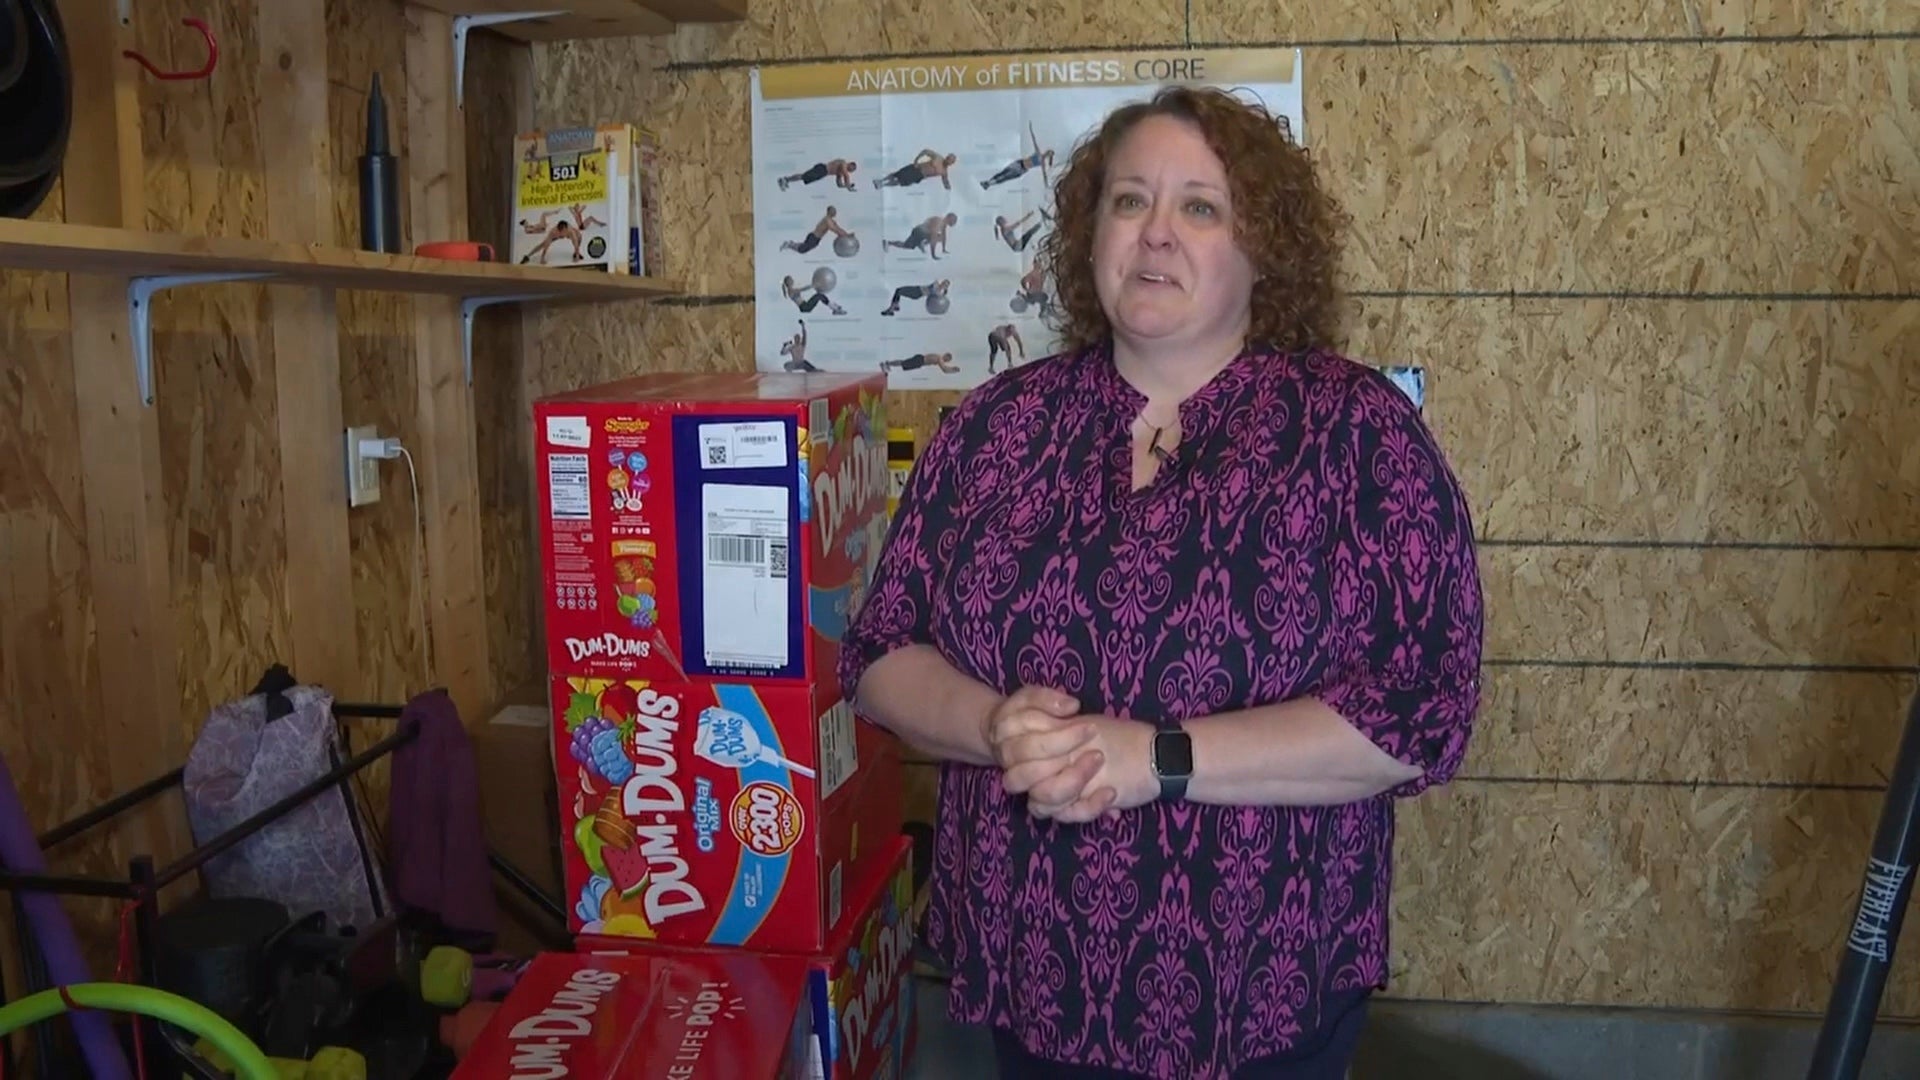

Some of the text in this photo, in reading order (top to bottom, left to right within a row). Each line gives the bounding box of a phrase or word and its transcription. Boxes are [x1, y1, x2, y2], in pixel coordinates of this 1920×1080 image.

[847, 66, 967, 91] ANATOMY
[976, 65, 999, 86] of
[1134, 58, 1205, 81] CORE
[531, 179, 595, 196] High Intensity
[552, 166, 577, 180] 501
[521, 190, 604, 206] Interval Exercises
[727, 717, 746, 756] DUMS
[748, 787, 782, 851] 2300
[781, 803, 794, 837] POPS
[1847, 857, 1912, 963] EVERLAST
[685, 981, 729, 1026] POP!
[676, 1031, 708, 1060] LIFE
